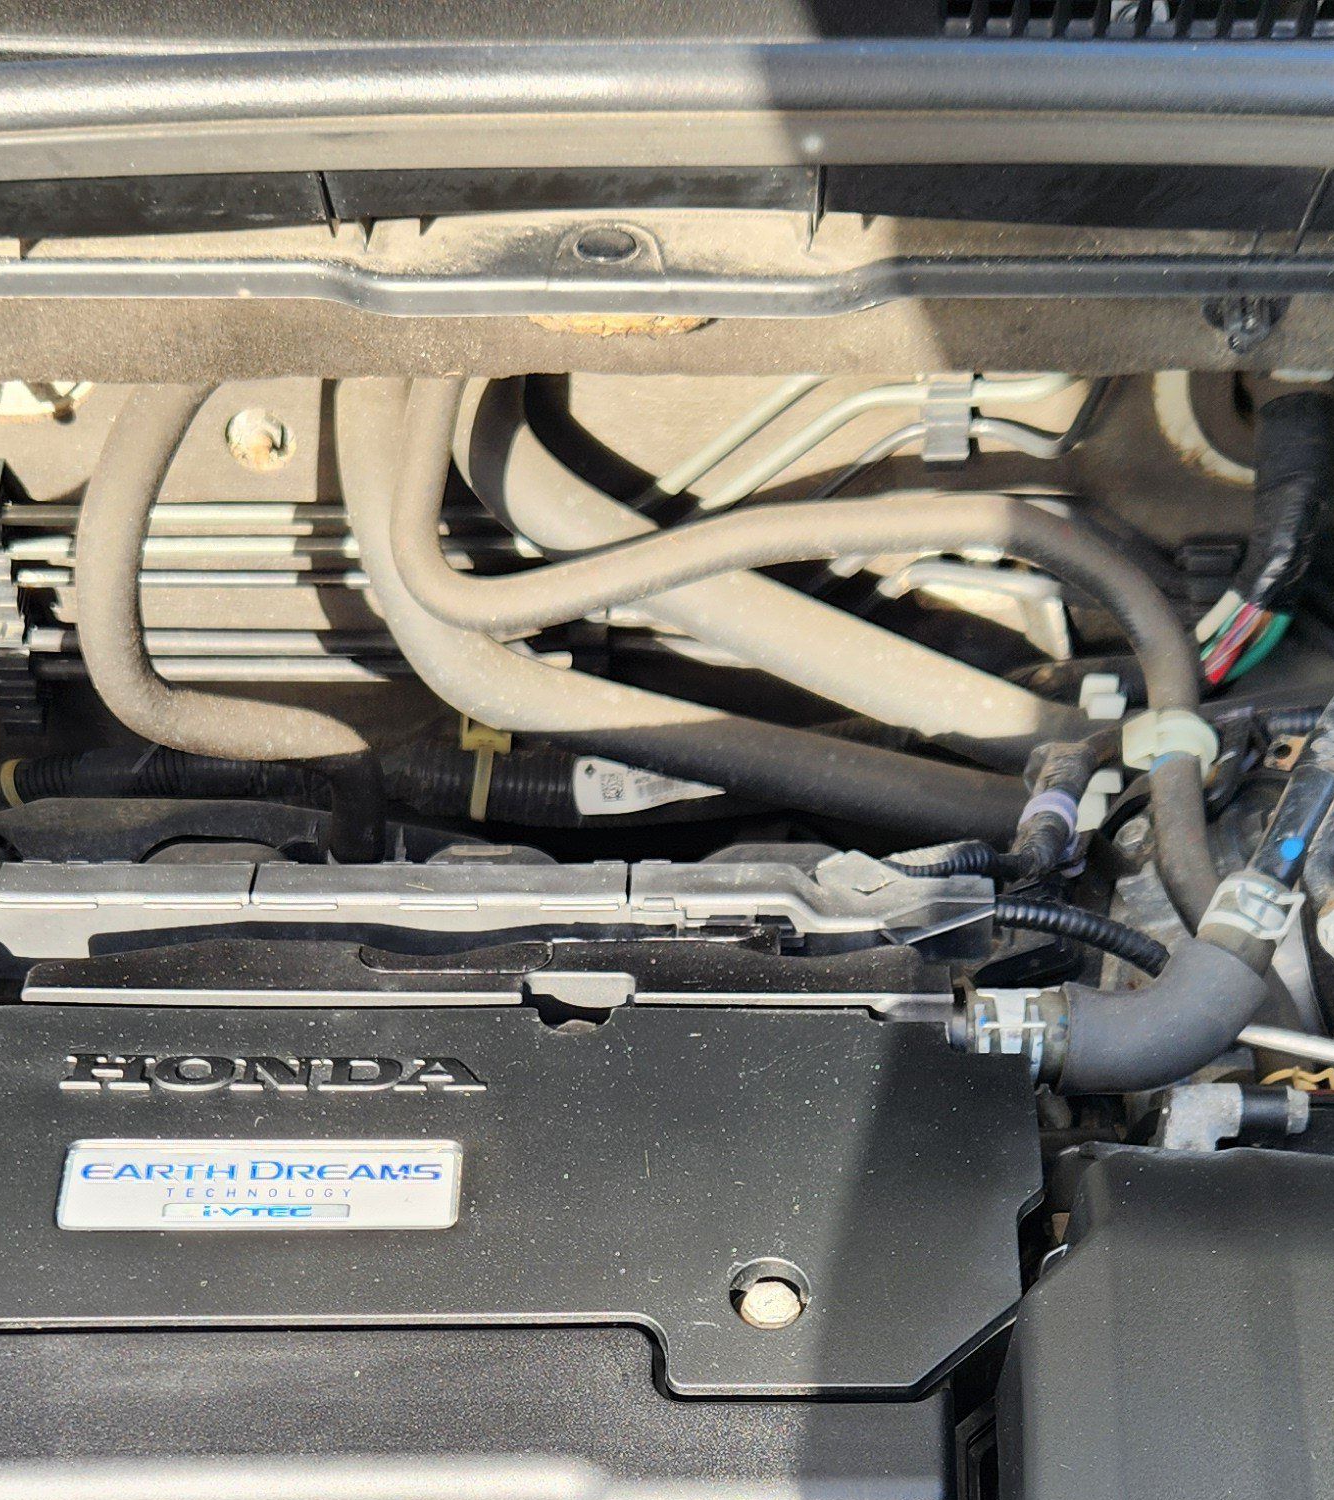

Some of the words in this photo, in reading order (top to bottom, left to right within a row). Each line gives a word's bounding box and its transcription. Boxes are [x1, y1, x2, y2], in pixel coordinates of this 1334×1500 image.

[59, 1053, 489, 1091] HONDA
[80, 1162, 239, 1182] EARTH
[167, 1187, 353, 1199] TECHNOLOGY
[202, 1204, 313, 1218] i-VTEC
